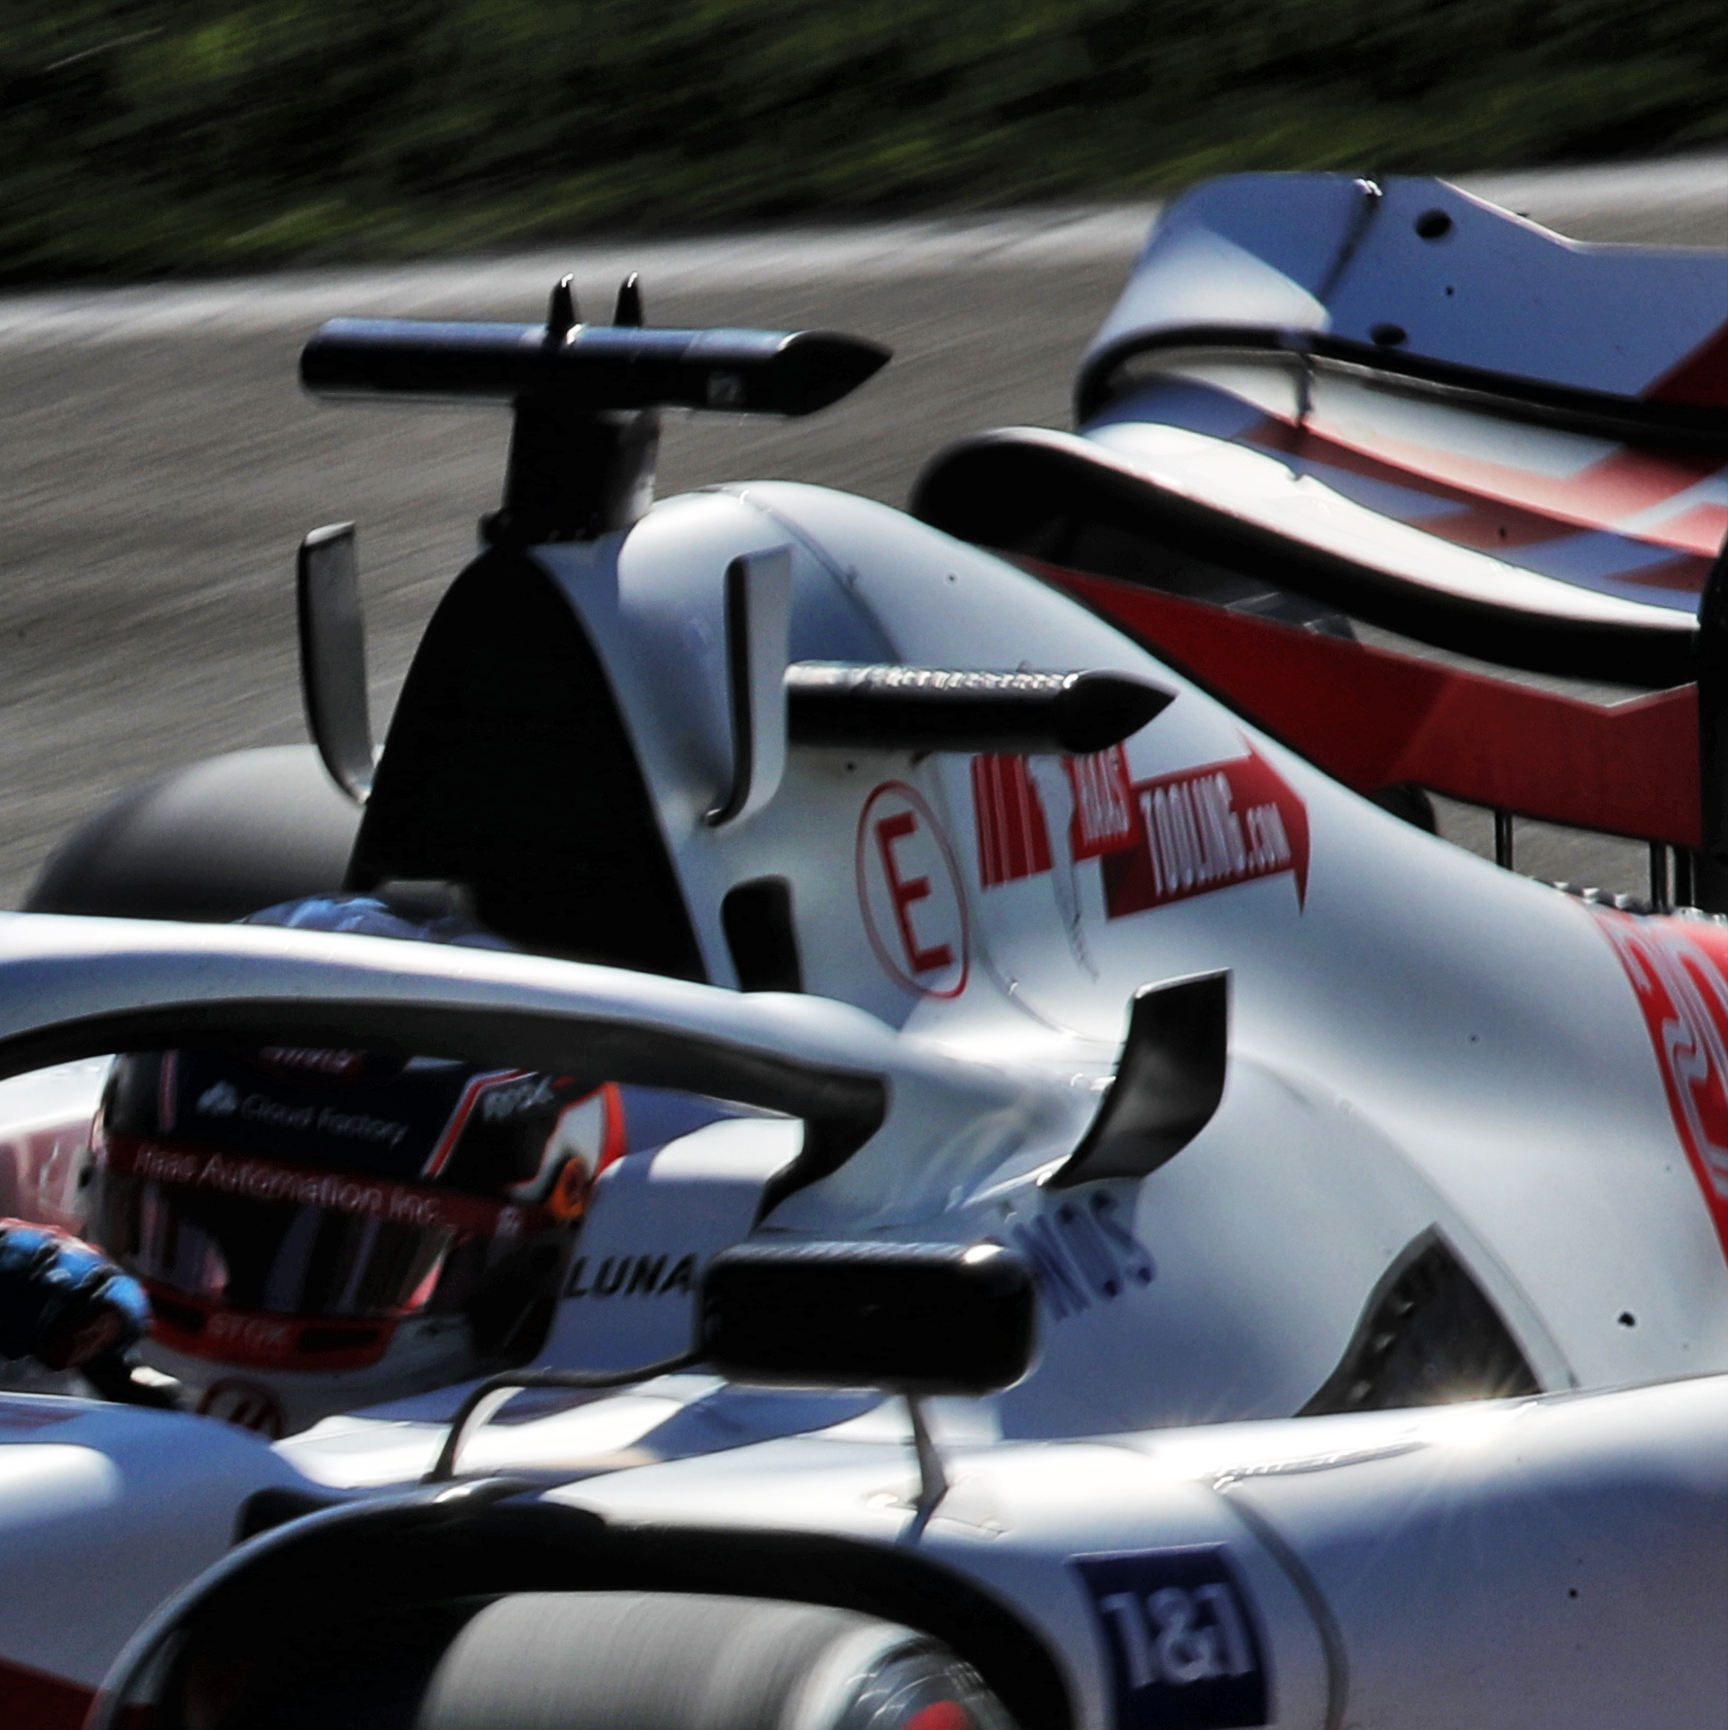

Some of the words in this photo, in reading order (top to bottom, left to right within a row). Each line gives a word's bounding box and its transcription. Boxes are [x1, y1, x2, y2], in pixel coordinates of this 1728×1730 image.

[133, 1142, 199, 1183] Haas
[198, 1152, 384, 1211] Automation
[561, 1253, 699, 1299] LUNA
[1099, 1581, 1257, 1691] 1&1
